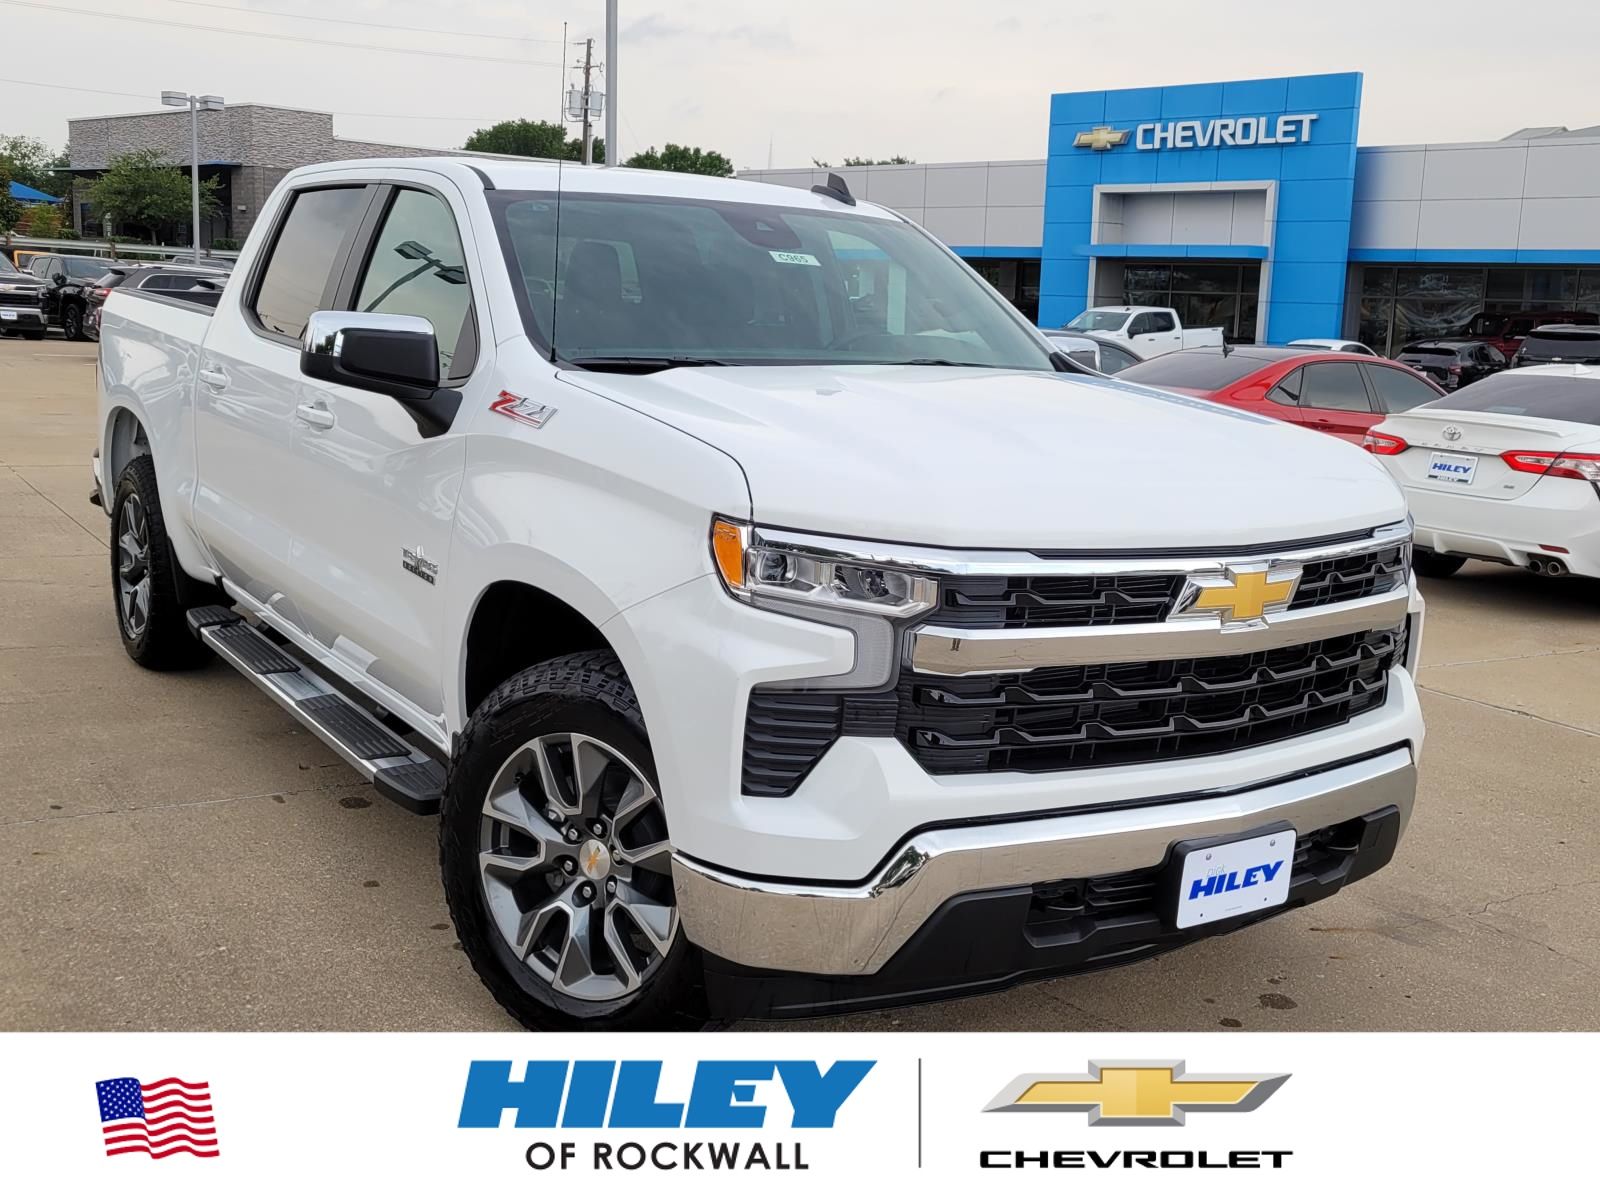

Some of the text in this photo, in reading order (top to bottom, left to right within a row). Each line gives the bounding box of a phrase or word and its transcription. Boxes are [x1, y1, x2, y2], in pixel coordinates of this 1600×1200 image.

[1136, 113, 1319, 150] CHEVROLET
[1431, 462, 1472, 474] HILEY
[1188, 860, 1284, 900] HILEY
